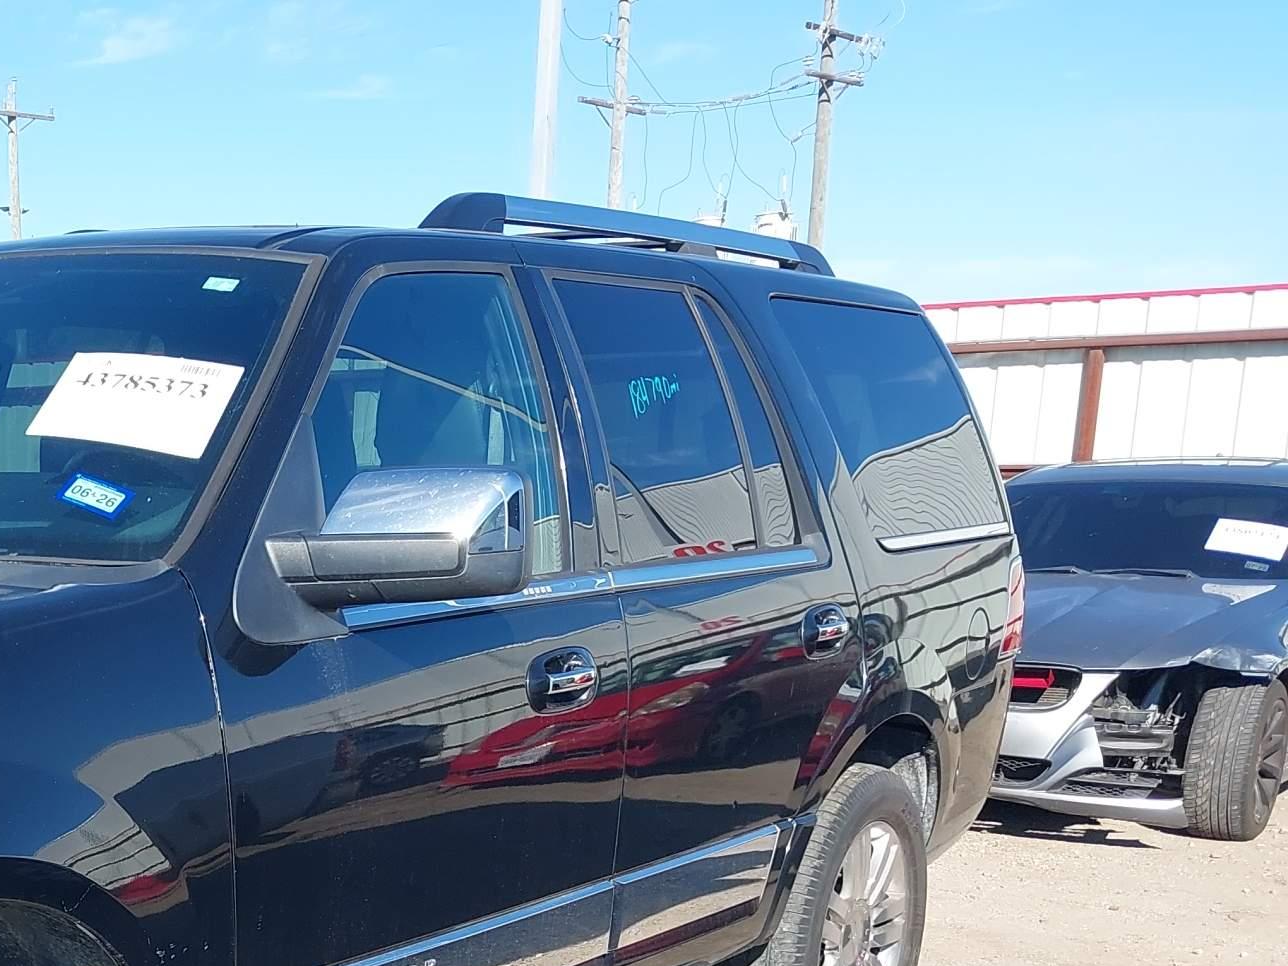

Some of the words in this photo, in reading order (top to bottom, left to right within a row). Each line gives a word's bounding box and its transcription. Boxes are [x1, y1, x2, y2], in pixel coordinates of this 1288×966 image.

[76, 372, 209, 399] 43785373
[71, 484, 92, 498] 06
[95, 493, 117, 508] 26
